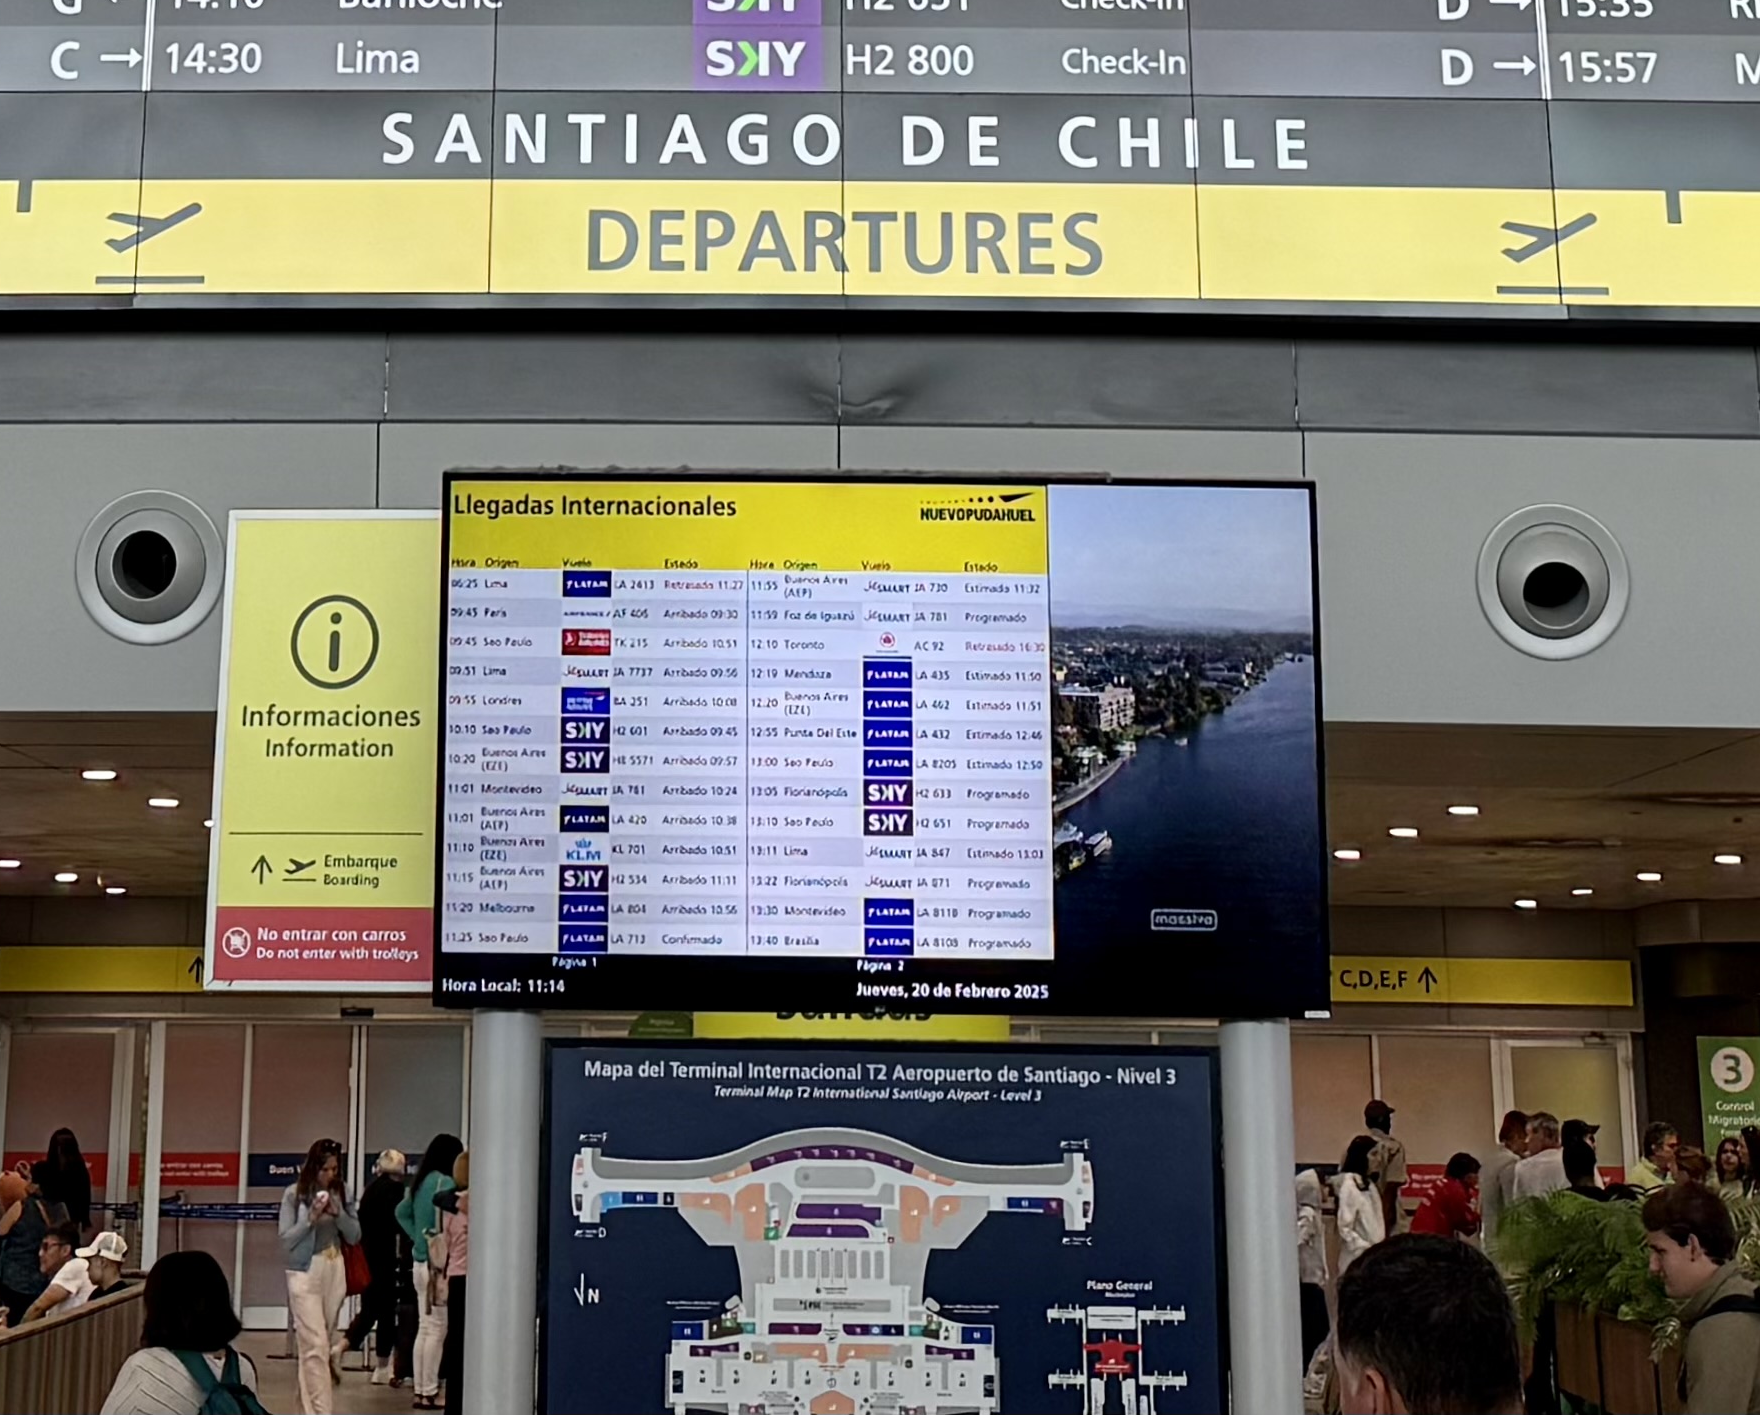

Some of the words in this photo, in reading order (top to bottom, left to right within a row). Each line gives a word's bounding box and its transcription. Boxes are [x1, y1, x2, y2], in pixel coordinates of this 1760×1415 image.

[383, 113, 840, 165] SANTIAGO
[903, 116, 999, 166] DE
[1059, 117, 1307, 169] CHILE
[588, 202, 1102, 281] DEPARTURES
[455, 494, 553, 519] Llegadas
[563, 496, 736, 516] Internacionales
[921, 508, 1035, 521] NUEVOPUDAHUEL
[243, 704, 420, 726] Informaciones
[266, 737, 393, 757] Information
[325, 855, 397, 870] Embarque
[324, 874, 379, 888] Boarding
[1155, 914, 1213, 925] massiva
[258, 928, 278, 940] No
[283, 929, 327, 940] entrar
[332, 931, 357, 941] con
[363, 931, 406, 941] carros
[257, 947, 274, 958] Do
[278, 949, 299, 959] not
[303, 949, 336, 959] enter
[340, 947, 368, 959] with
[373, 948, 418, 962] trolleys
[443, 978, 476, 991] Hora
[482, 978, 521, 992] Local:
[528, 980, 564, 992] 11:14
[1340, 970, 1407, 990] C,D,E,F
[857, 982, 908, 998] Jueves,
[912, 983, 930, 997] 20
[933, 982, 951, 997] de
[955, 983, 1011, 998] Febrero
[1014, 985, 1048, 998] 2025
[585, 1061, 632, 1080] Mapa
[638, 1061, 664, 1077] del
[670, 1062, 742, 1078] Terminal
[749, 1063, 861, 1080] Internacional
[866, 1064, 886, 1080] T2
[893, 1065, 992, 1085] Aeropuerto
[998, 1066, 1018, 1082] de
[1024, 1067, 1100, 1087] Santiago
[1118, 1068, 1160, 1084] Nivel
[1167, 1069, 1175, 1084] 3
[1723, 1054, 1742, 1084] 3
[715, 1085, 764, 1097] Terminal
[767, 1086, 793, 1099] Map
[798, 1087, 810, 1098] T2
[813, 1087, 889, 1098] International
[892, 1088, 944, 1102] Santiago
[947, 1089, 989, 1102] Airport
[1001, 1089, 1032, 1101] Level
[1035, 1090, 1041, 1101] 3
[1716, 1101, 1754, 1111] Control
